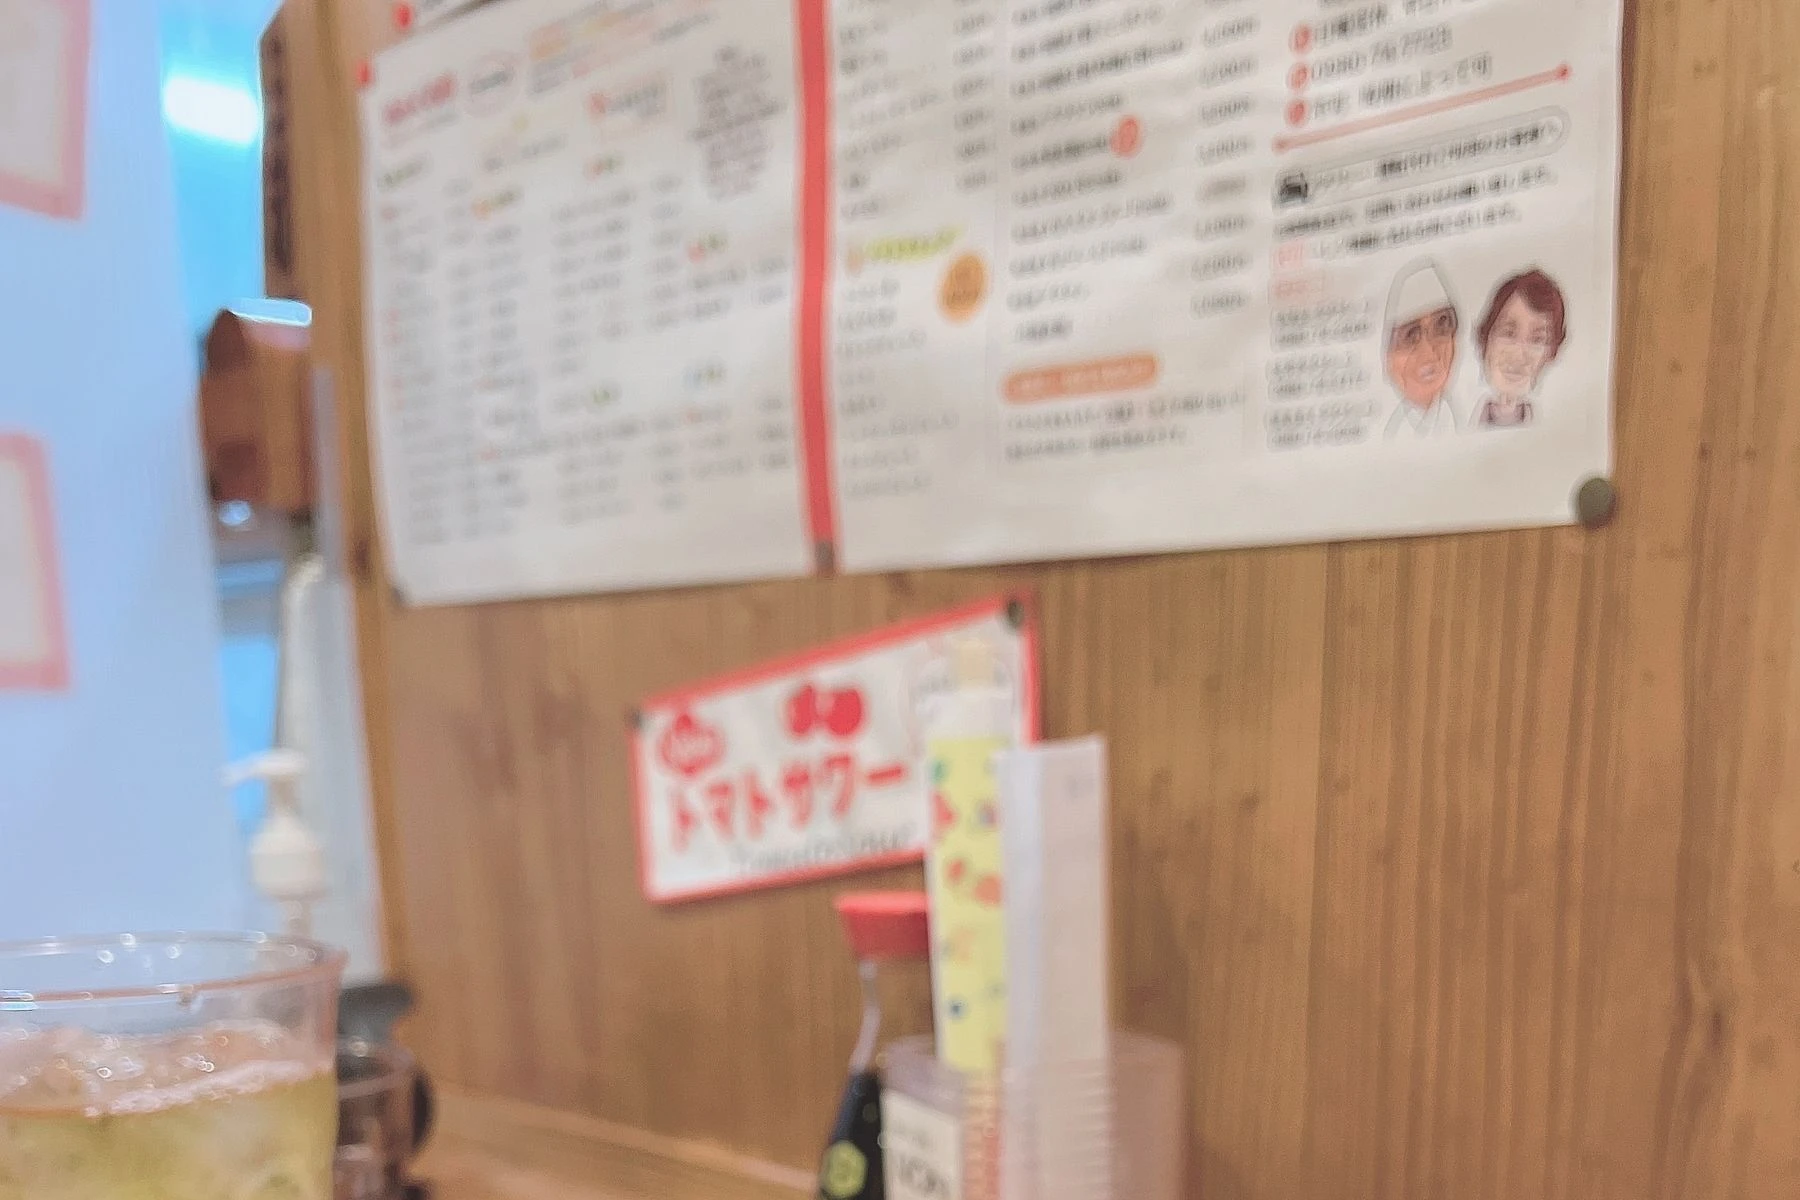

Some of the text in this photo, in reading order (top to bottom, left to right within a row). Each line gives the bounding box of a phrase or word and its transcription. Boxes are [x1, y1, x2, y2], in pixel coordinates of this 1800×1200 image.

[667, 752, 907, 853] トマトサワー
